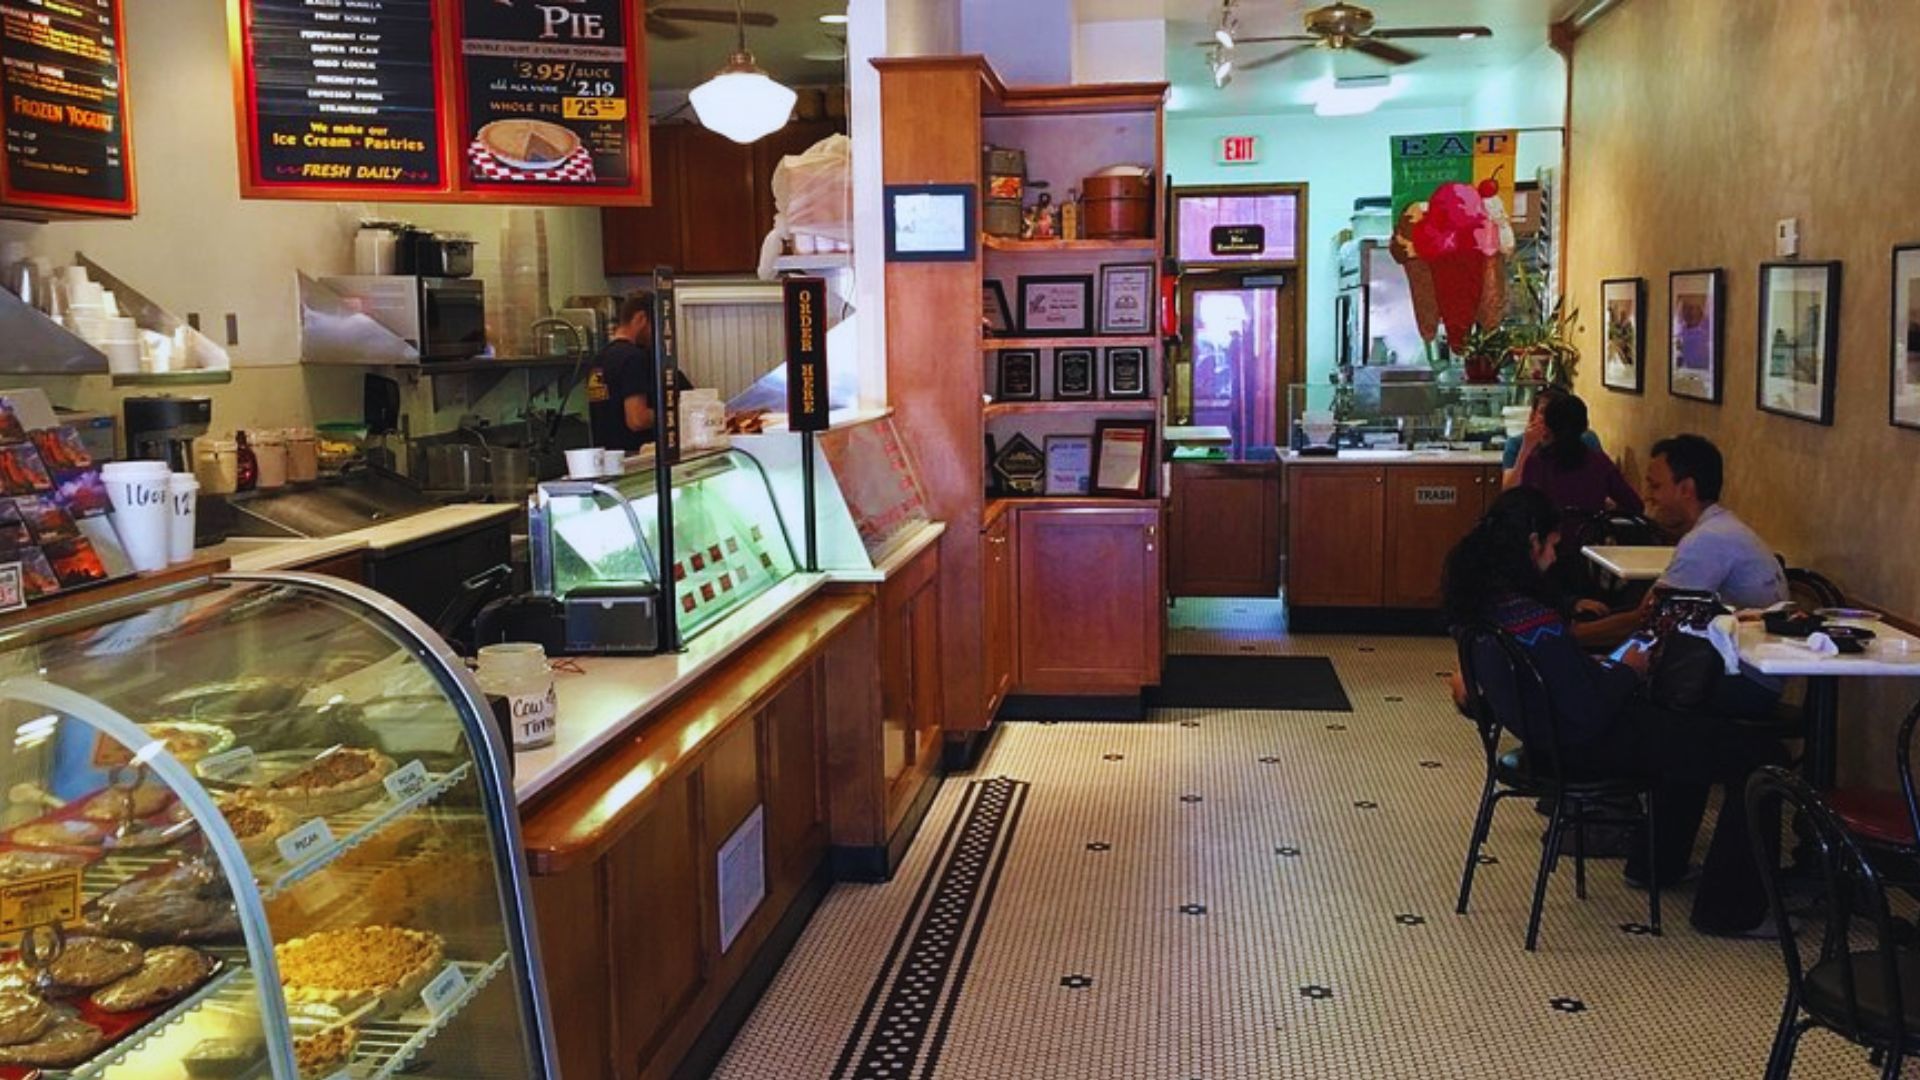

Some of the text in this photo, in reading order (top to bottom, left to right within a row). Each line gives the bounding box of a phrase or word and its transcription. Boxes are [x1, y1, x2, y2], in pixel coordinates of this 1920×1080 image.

[535, 5, 605, 39] PIE
[13, 95, 63, 122] FROZEN
[490, 100, 536, 113] WHOLE
[539, 103, 560, 114] PIE
[310, 121, 388, 136] We make our
[272, 133, 425, 151] Ice Cream Pastries
[1225, 136, 1255, 161] EXIT
[1401, 134, 1508, 157] EAT
[302, 163, 402, 180] FRESH DAILY
[799, 289, 815, 414] ORDER HERE
[1417, 488, 1455, 501] TRASH
